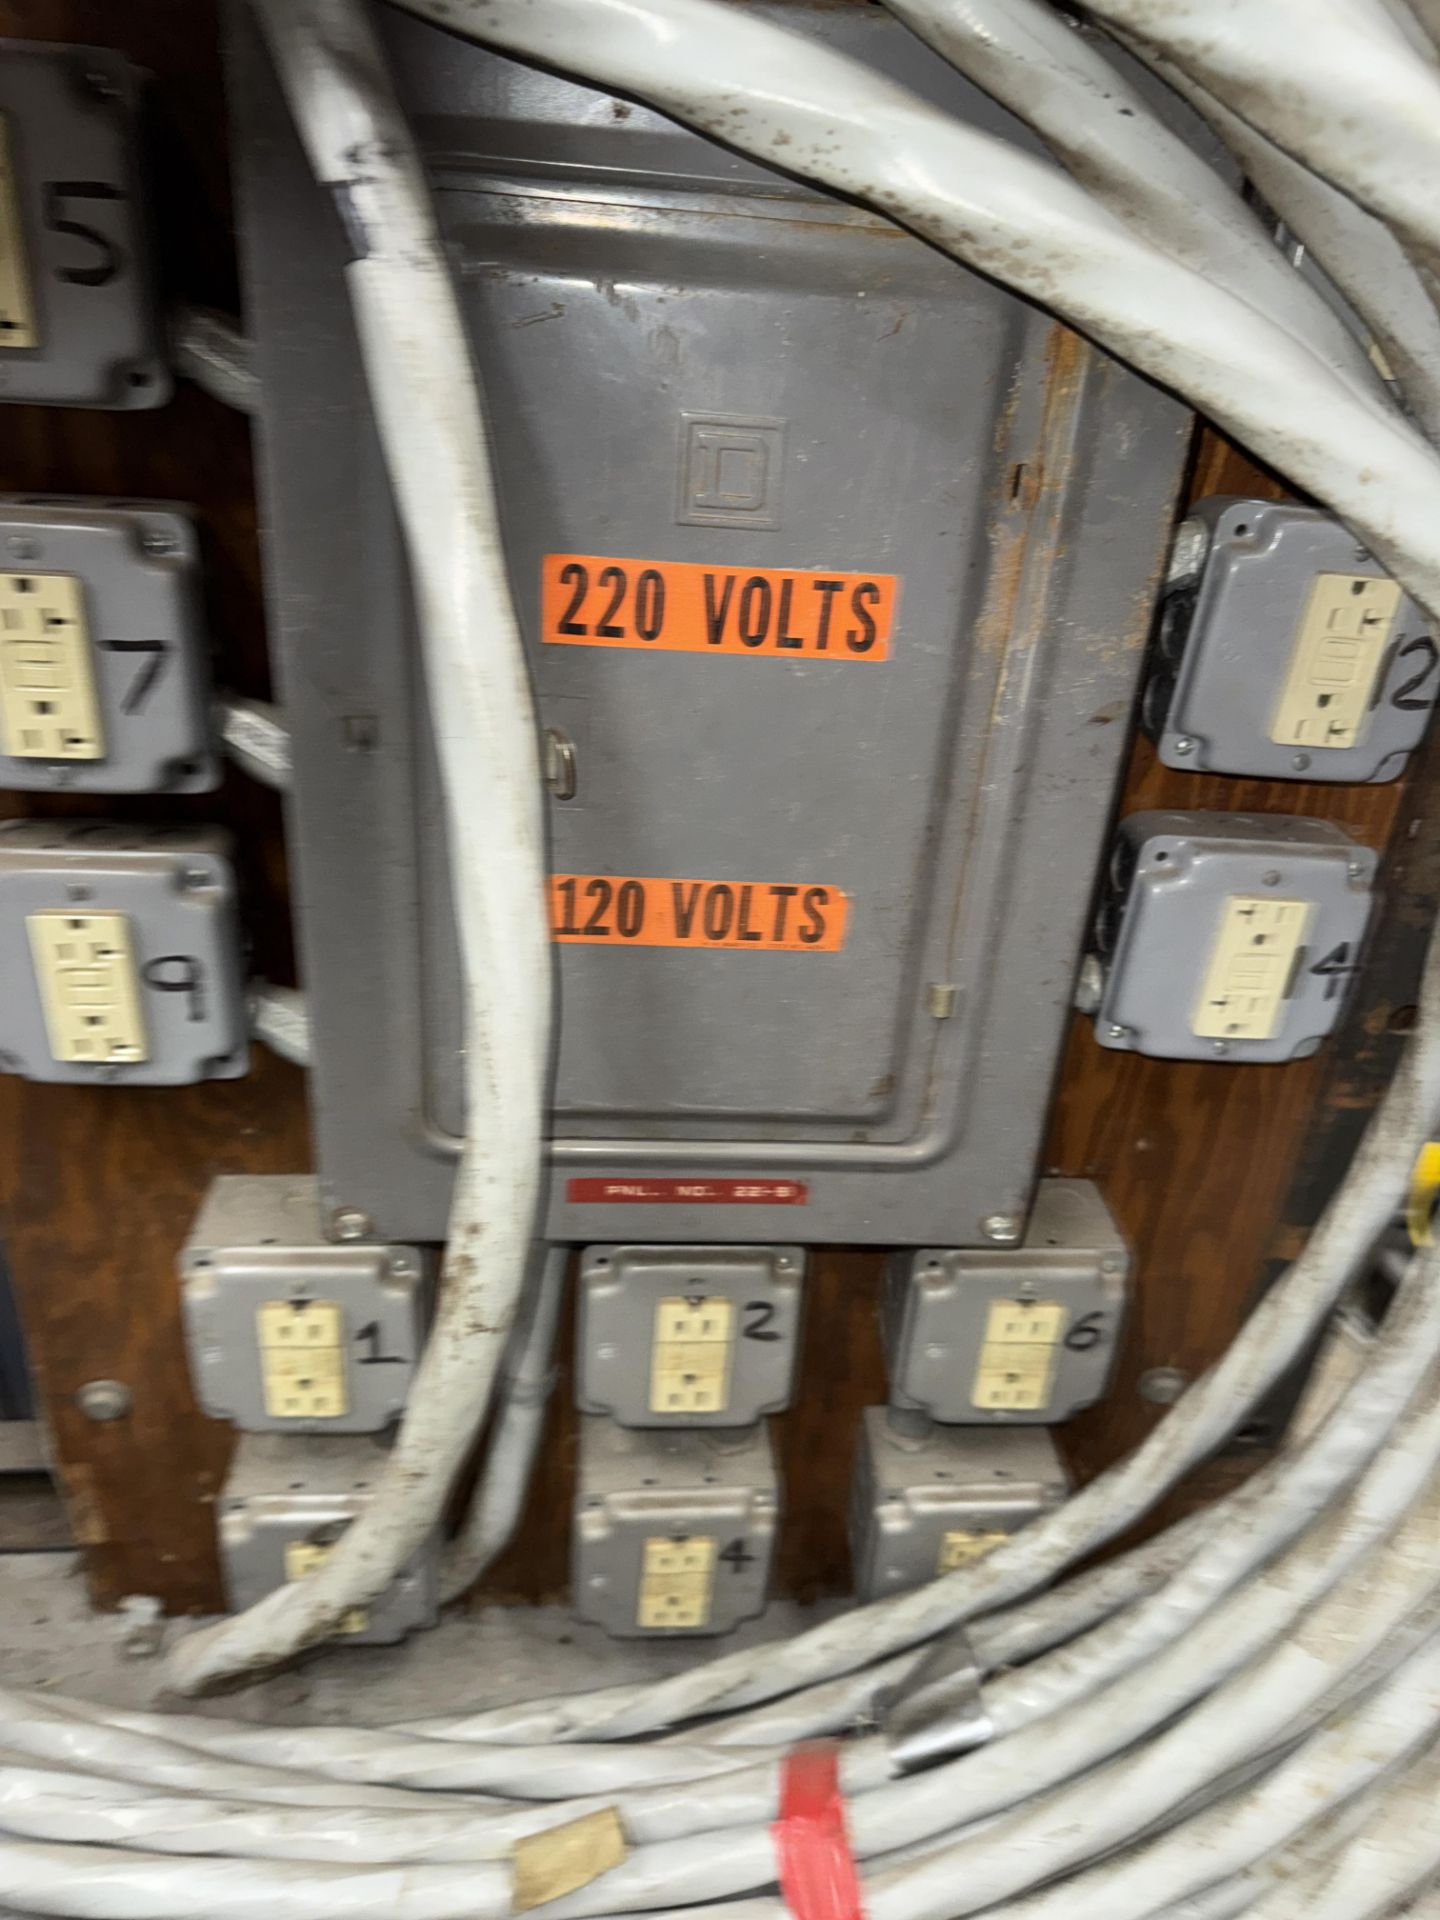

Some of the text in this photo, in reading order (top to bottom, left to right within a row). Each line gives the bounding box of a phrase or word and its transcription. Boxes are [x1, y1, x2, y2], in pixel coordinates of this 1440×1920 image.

[44, 181, 124, 286] 5
[558, 563, 880, 652] 220 VOLTS
[100, 640, 170, 715] 7
[1370, 632, 1439, 711] 12
[551, 878, 829, 943] 120 VOLTS
[143, 956, 205, 1022] 9
[352, 1320, 408, 1364] 1
[741, 1300, 782, 1342] 2
[1064, 1311, 1105, 1351] 6
[718, 1538, 755, 1573] 4
